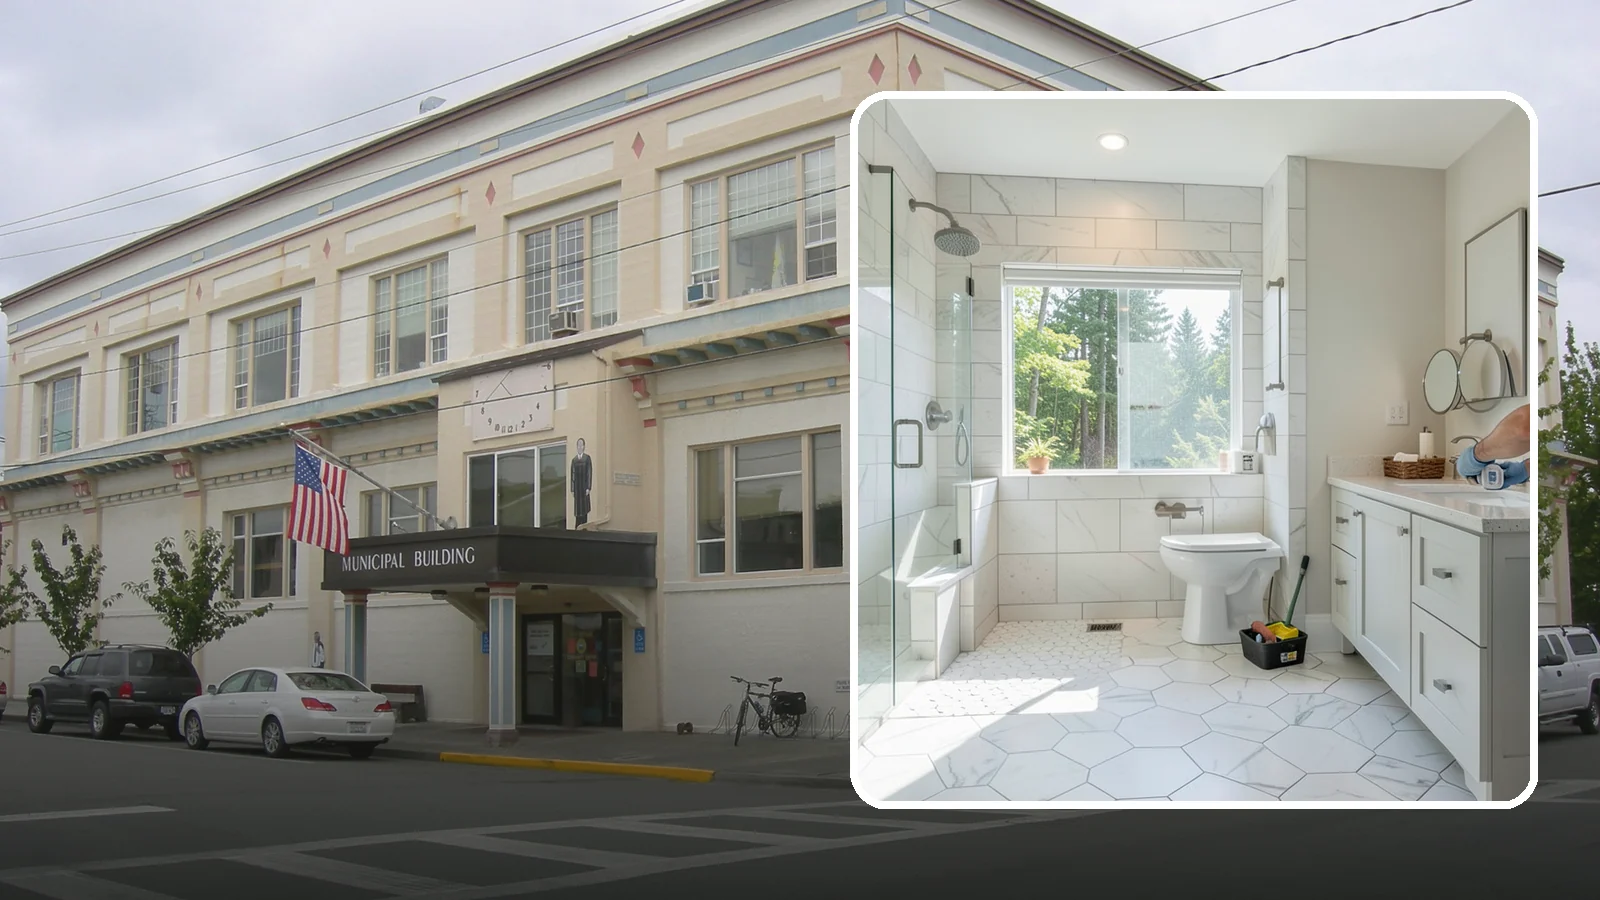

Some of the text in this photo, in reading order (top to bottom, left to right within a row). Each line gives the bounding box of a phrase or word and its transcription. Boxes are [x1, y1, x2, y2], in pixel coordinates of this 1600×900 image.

[481, 407, 485, 415] 8
[488, 417, 493, 426] 9
[494, 423, 500, 432] 10
[502, 425, 506, 434] 11
[507, 425, 513, 433] 12
[521, 420, 526, 428] 2
[528, 413, 533, 422] 3
[536, 402, 540, 410] 4
[342, 546, 475, 572] MUNICIPAL BUILDING
